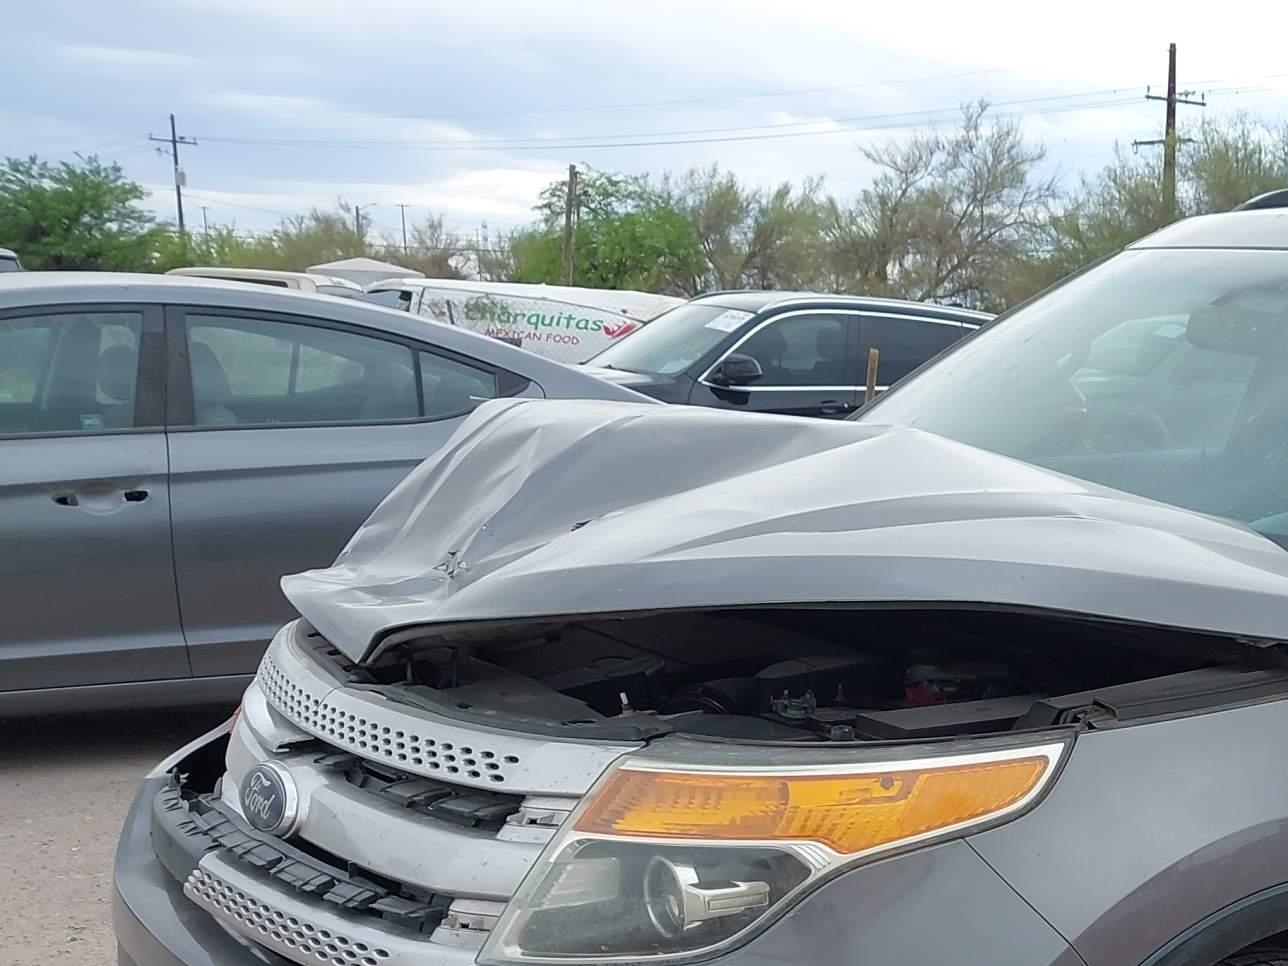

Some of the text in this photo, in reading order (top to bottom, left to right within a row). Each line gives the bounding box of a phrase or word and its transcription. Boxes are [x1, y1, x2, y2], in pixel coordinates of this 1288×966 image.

[484, 327, 581, 346] MEXICAN FOOD
[246, 771, 276, 820] Ford
